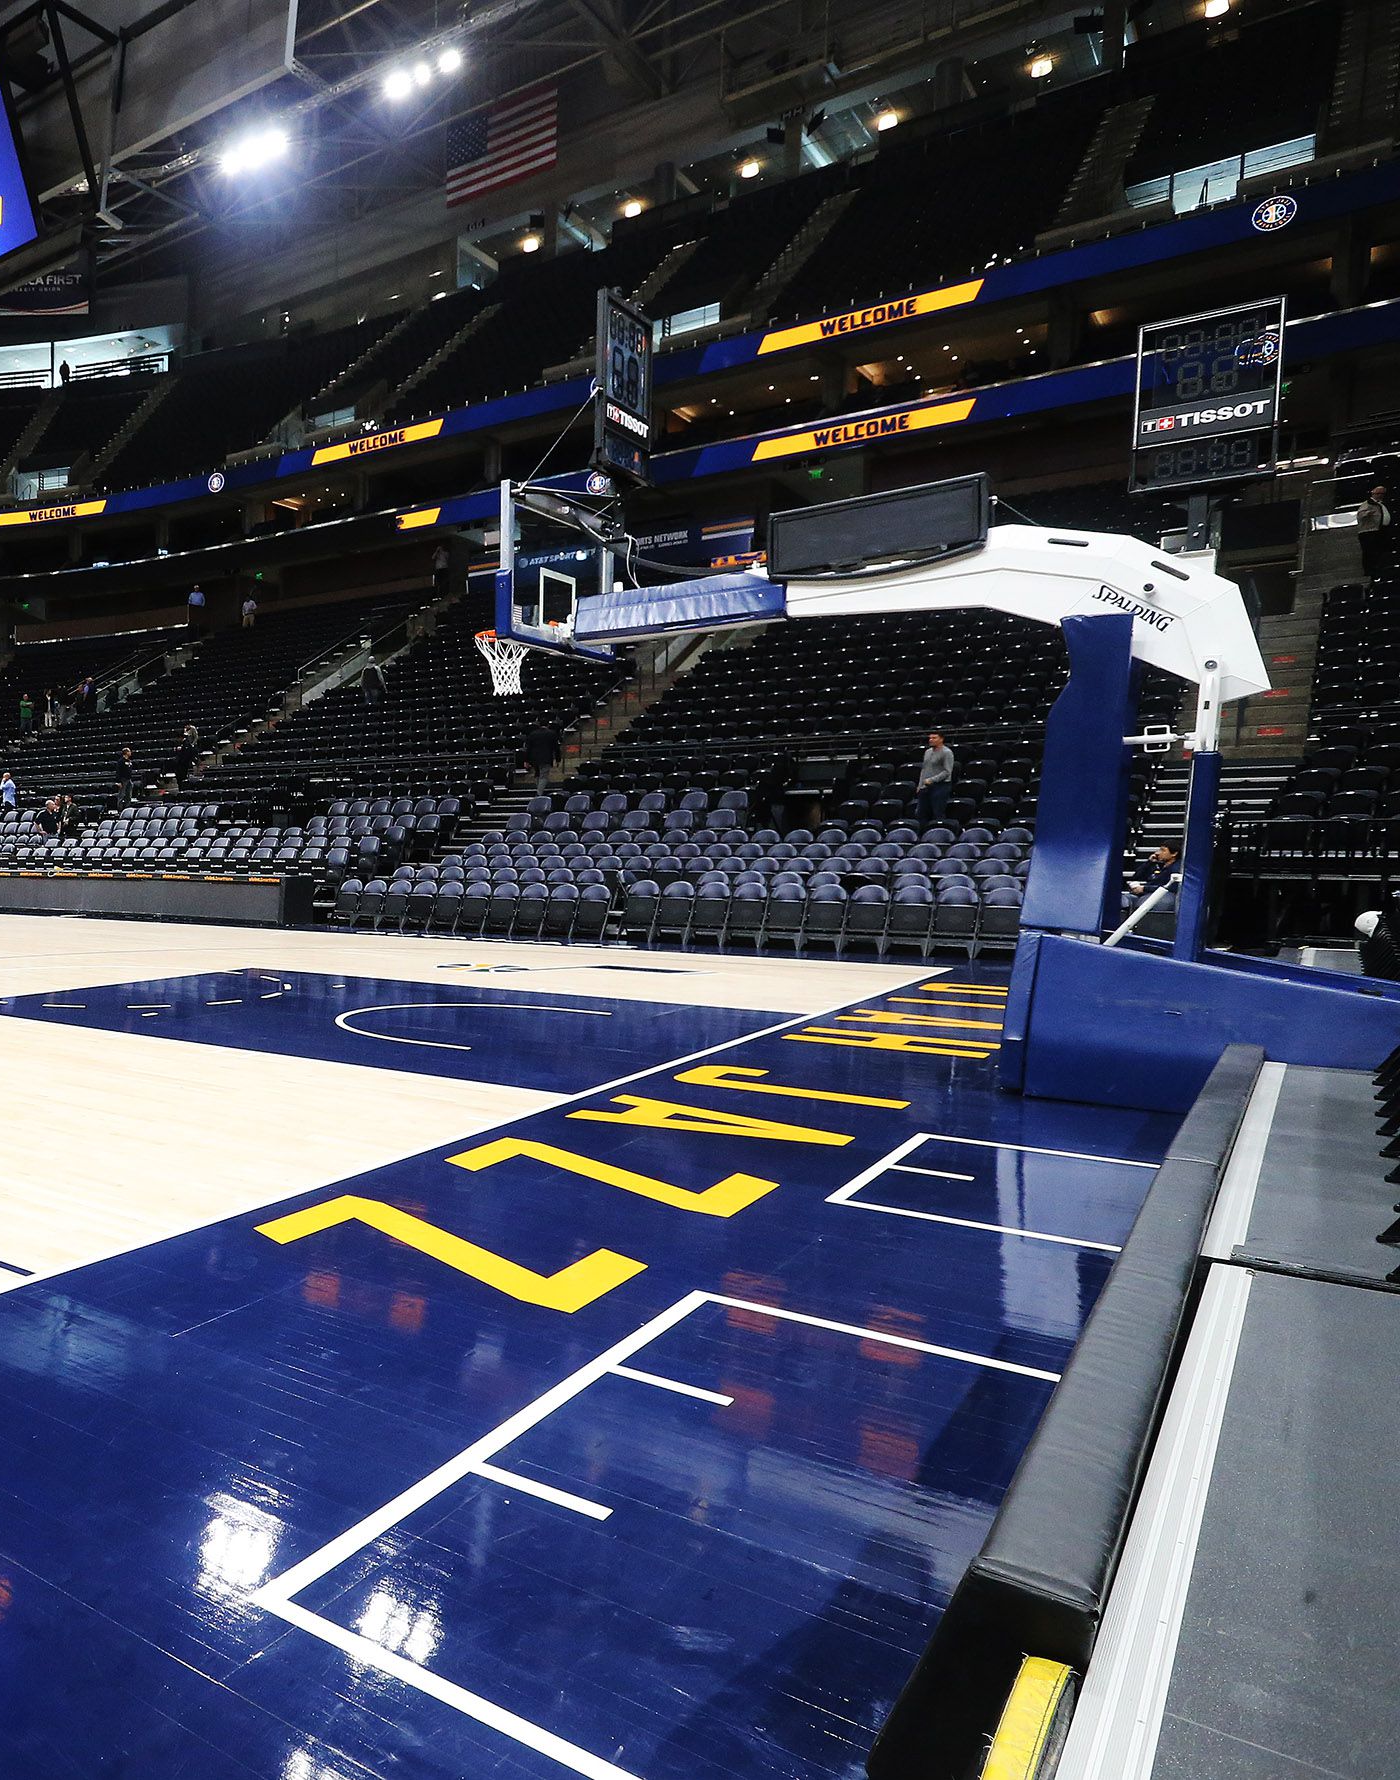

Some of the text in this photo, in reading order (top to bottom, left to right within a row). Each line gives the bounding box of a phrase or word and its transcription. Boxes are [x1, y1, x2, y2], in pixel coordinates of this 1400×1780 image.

[46, 274, 82, 285] FIRST
[820, 298, 918, 337] WELCOME
[619, 407, 649, 439] TISSOT
[1176, 400, 1271, 427] TISSOT
[348, 430, 405, 455] WELCOME
[813, 414, 910, 447] WELCOME
[29, 506, 77, 521] WELCOME
[1092, 585, 1174, 632] SPALDING
[253, 1065, 911, 1314] JAZZ
